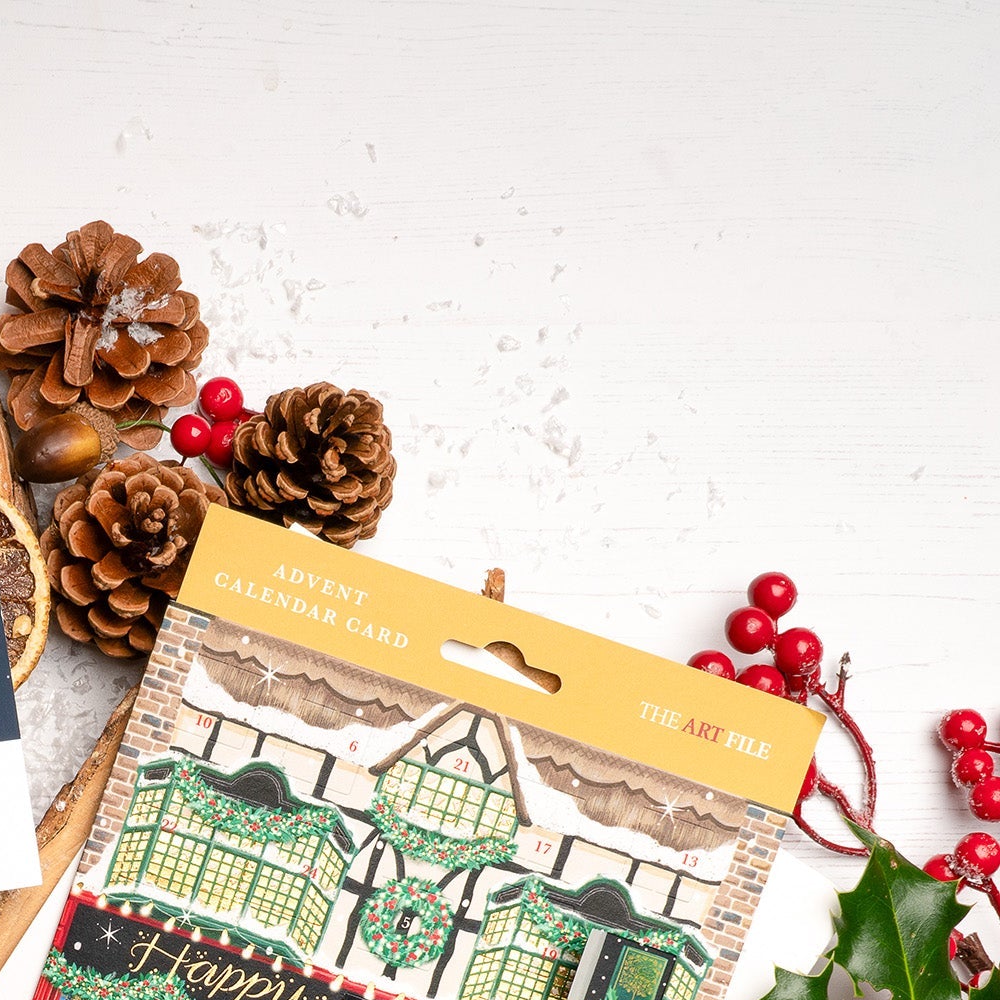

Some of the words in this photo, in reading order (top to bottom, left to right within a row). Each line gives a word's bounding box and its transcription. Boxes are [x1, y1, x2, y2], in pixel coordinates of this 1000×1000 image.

[272, 563, 369, 606] ADVENT
[214, 571, 338, 626] CALENDAR
[345, 617, 410, 650] CARD
[195, 714, 213, 729] 10
[639, 700, 682, 730] THE
[681, 717, 724, 743] ART
[724, 732, 772, 761] FILE
[348, 740, 359, 753] 6
[453, 757, 470, 773] 21
[161, 818, 178, 833] 22
[534, 839, 552, 855] 17
[681, 852, 699, 868] 13
[301, 865, 318, 880] 24
[401, 916, 411, 930] 5
[541, 946, 558, 961] 19
